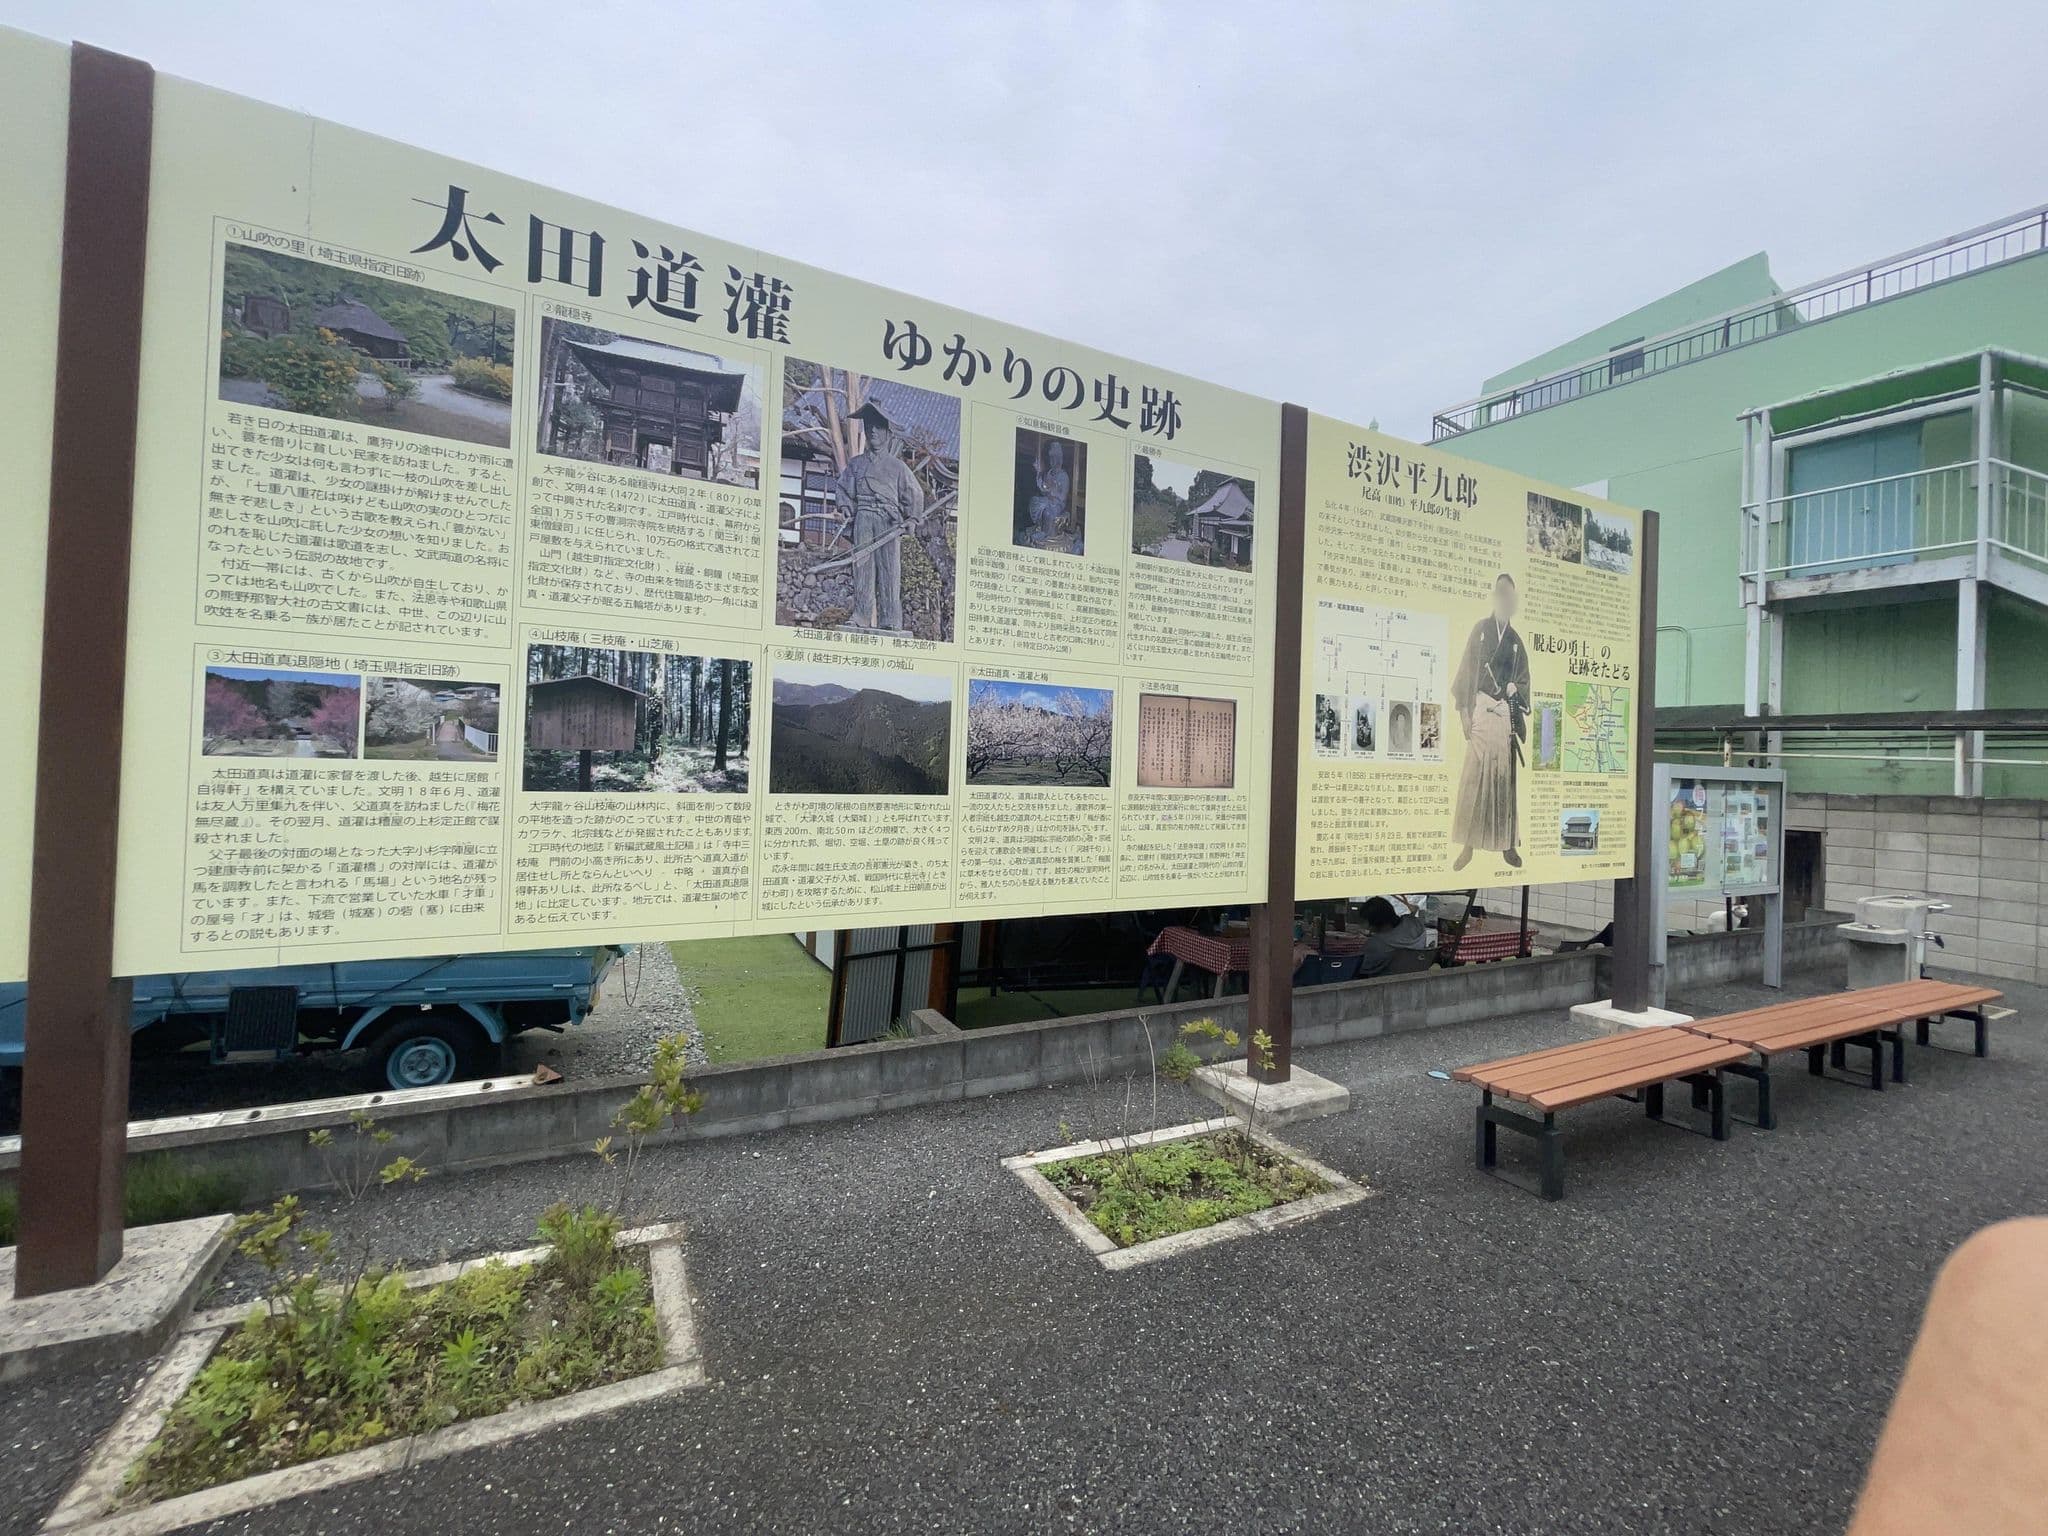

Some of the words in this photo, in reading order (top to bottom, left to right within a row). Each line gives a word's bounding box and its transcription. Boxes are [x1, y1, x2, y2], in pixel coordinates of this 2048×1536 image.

[410, 185, 792, 345] 太田道灌
[883, 318, 1183, 441] ゆかりの史跡
[210, 457, 511, 511] ました。道灌は、少女の謎掛けが解けませんでした
[211, 441, 512, 497] 出てきた少女は何も言わずに一枝の山吹を差し出し
[1347, 441, 1479, 509] 渋沢平九郎
[209, 473, 512, 525] が、「七重八重花は咲けども山吹の実のひとつだに
[207, 522, 509, 568] のれを恥じた道灌は歌道を志し、文武両道の名将に
[208, 506, 510, 554] 悲しさを山吹に託した少女の想いを知りました。お
[207, 537, 395, 570] なったという伝説の故地です。
[205, 571, 508, 611] つては地名も山吹でした。また、法恩寺や和歌山県
[221, 556, 508, 597] 付近一帯には、古くから山吹が自生しており、か
[204, 587, 507, 625] の熊野那智大社の古文書には、中世、この辺りに山
[204, 603, 488, 638] 吹姓を名乗る一族が居たことが記されています。
[1527, 632, 1612, 661] 「脱走の勇士」の
[1568, 658, 1631, 682] 足跡をたどる
[194, 831, 289, 844] 殺されました。
[763, 850, 793, 860] います。
[189, 923, 340, 943] するとの説もあります。
[513, 908, 616, 924] あると伝えています。
